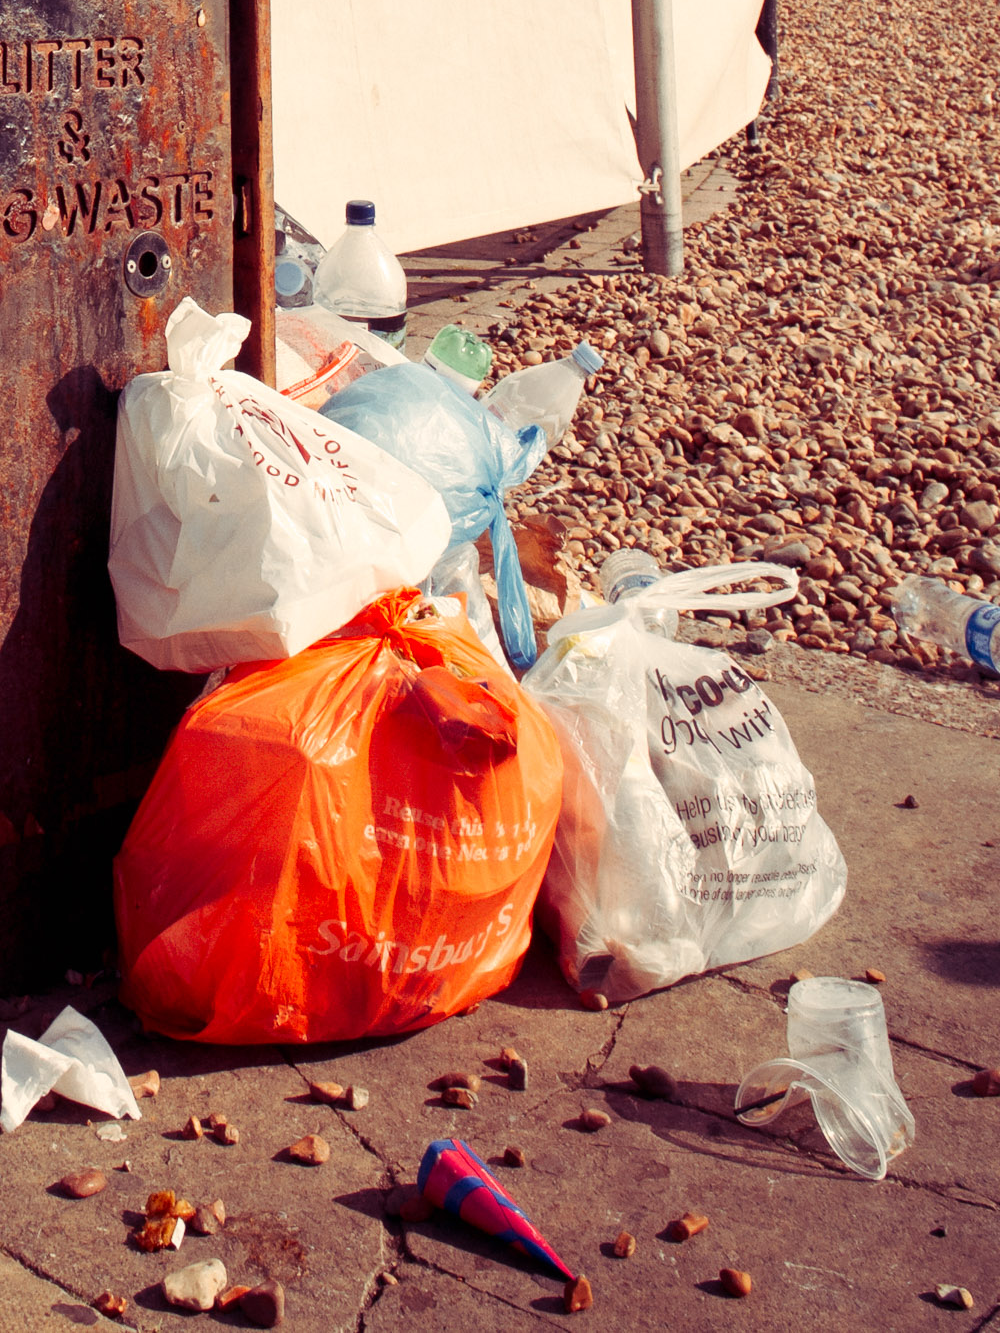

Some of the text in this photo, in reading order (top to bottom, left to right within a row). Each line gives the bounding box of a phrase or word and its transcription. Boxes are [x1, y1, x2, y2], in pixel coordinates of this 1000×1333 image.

[0, 36, 145, 94] LITTER
[58, 110, 91, 164] &
[56, 171, 213, 237] WASTE
[676, 795, 712, 821] Help
[690, 887, 711, 900] one
[710, 871, 725, 883] no
